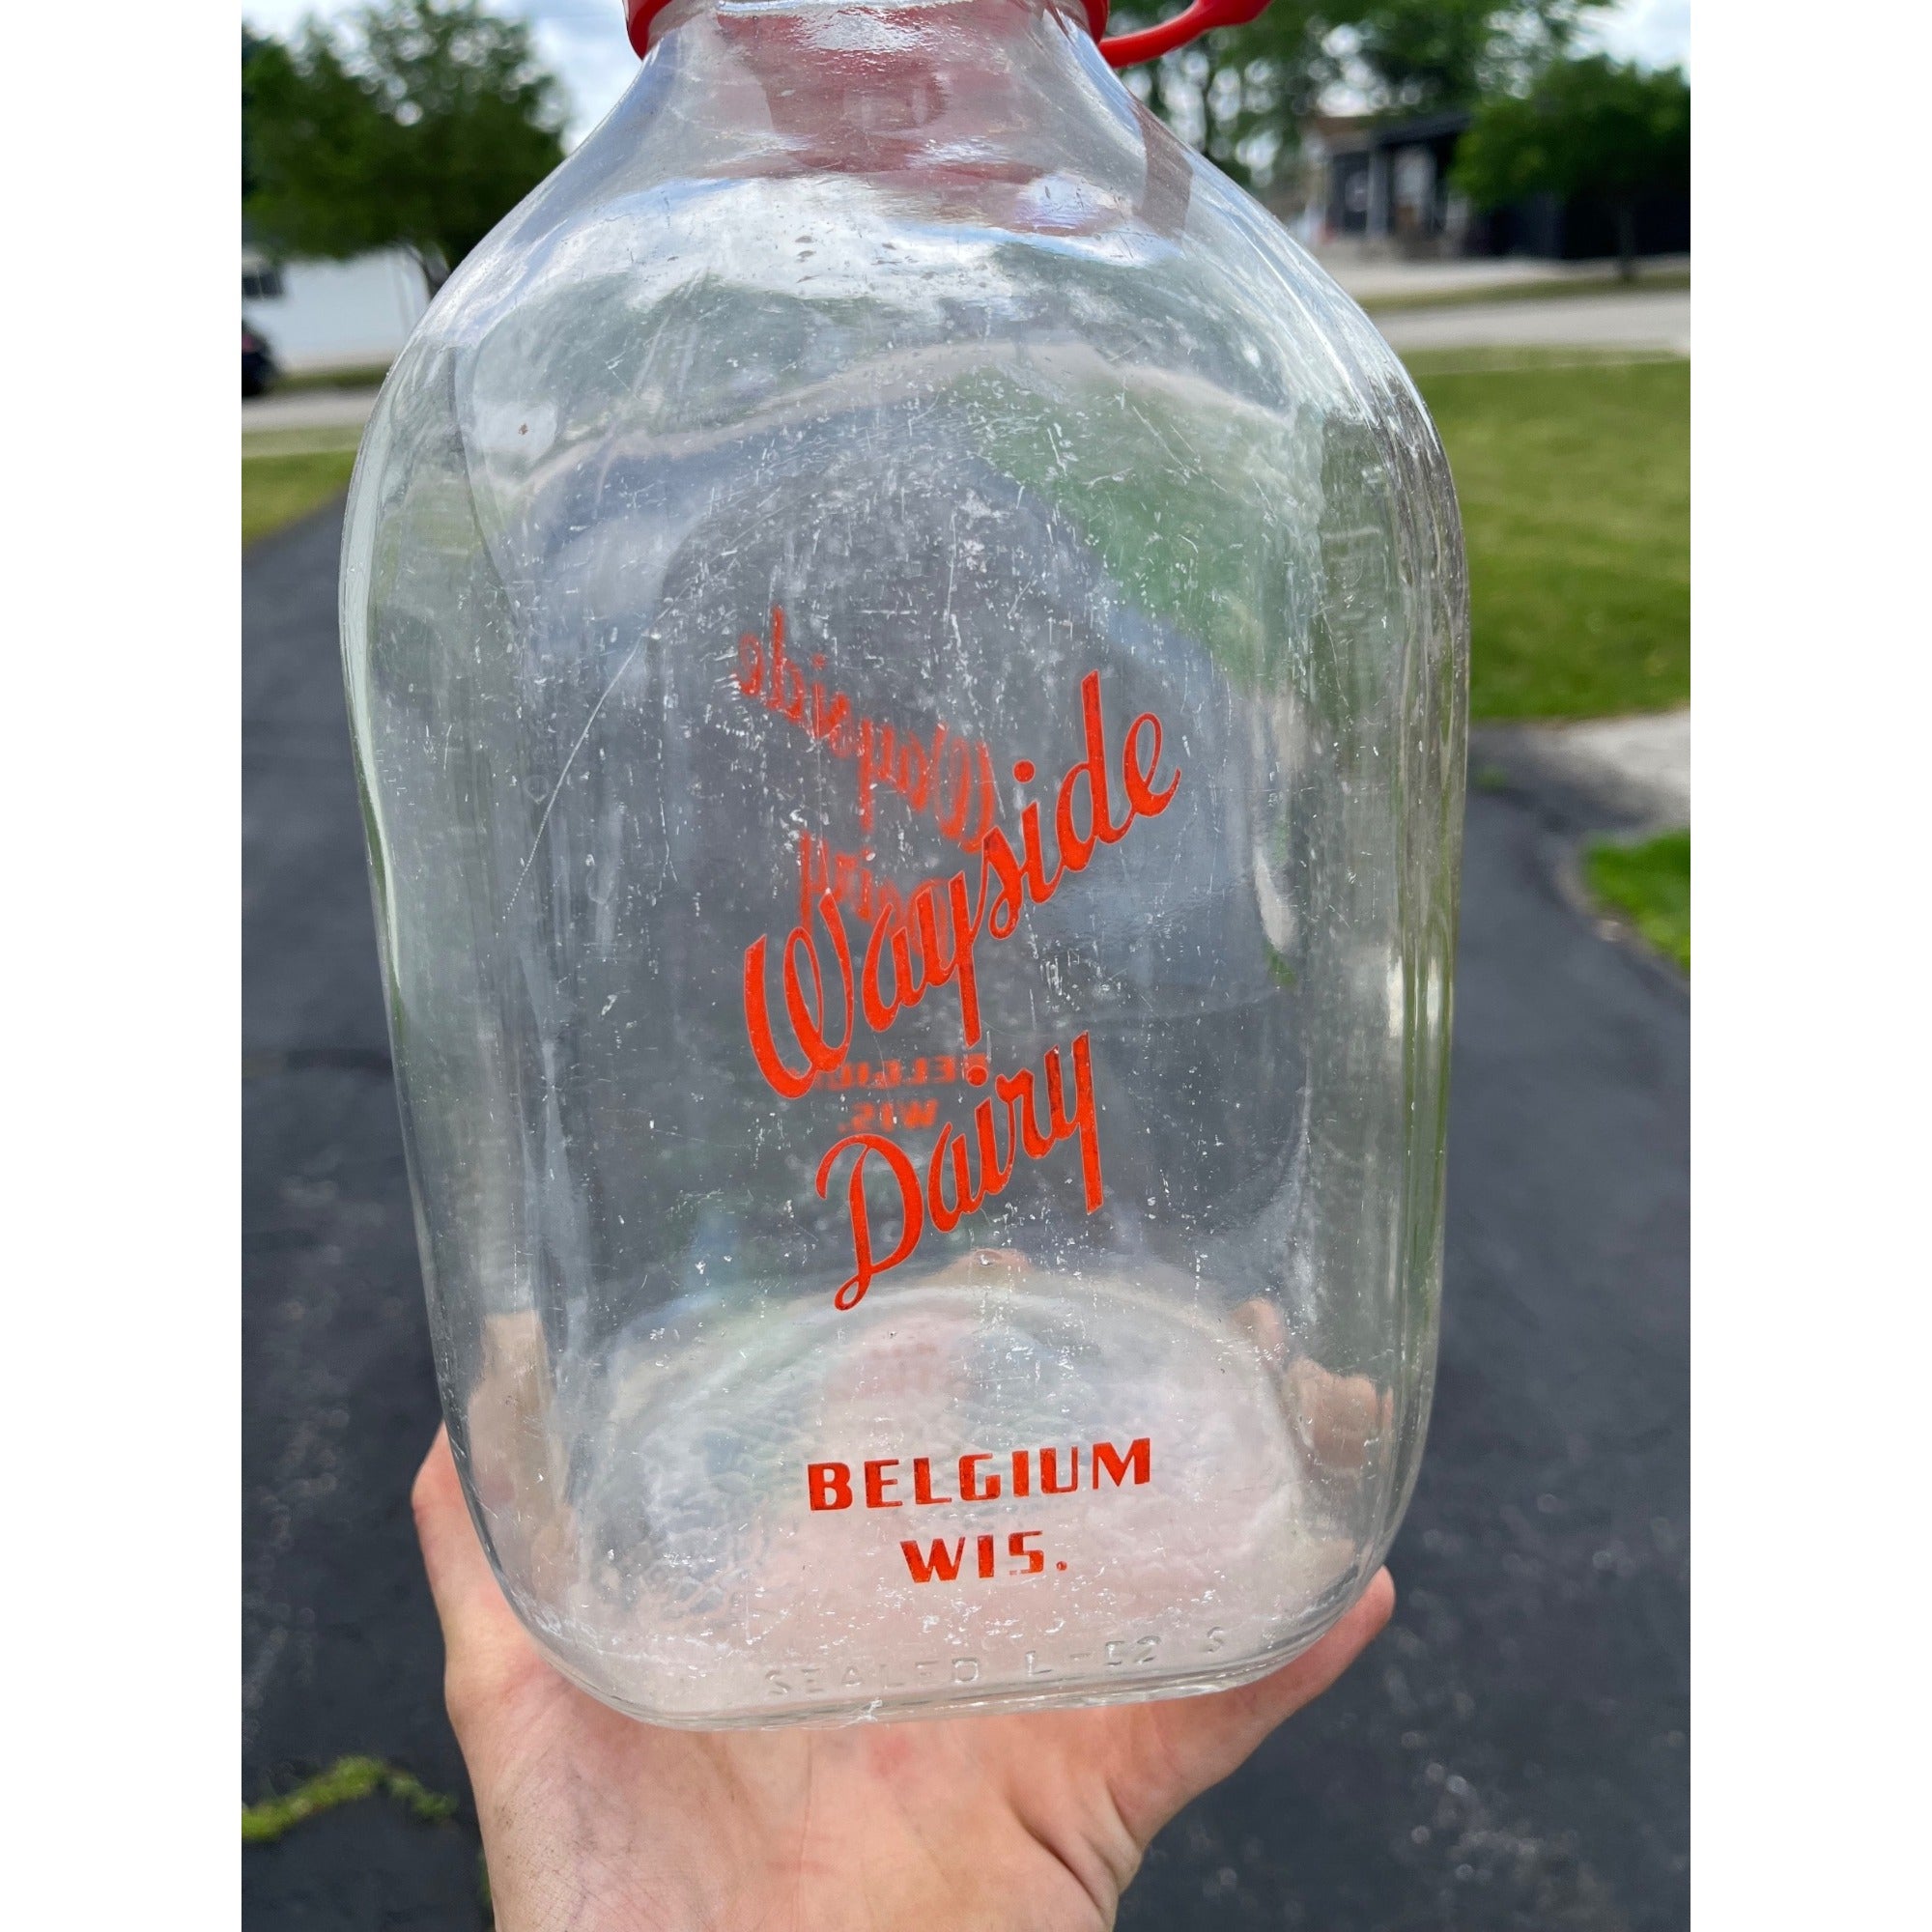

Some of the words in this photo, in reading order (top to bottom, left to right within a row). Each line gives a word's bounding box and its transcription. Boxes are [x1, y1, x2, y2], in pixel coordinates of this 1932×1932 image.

[743, 669, 1181, 1099] Wayside
[815, 1030, 1104, 1311] Dairy
[807, 1437, 1151, 1511] BELGIUM
[899, 1530, 1068, 1583] WIS.
[765, 1656, 980, 1696] SEALED
